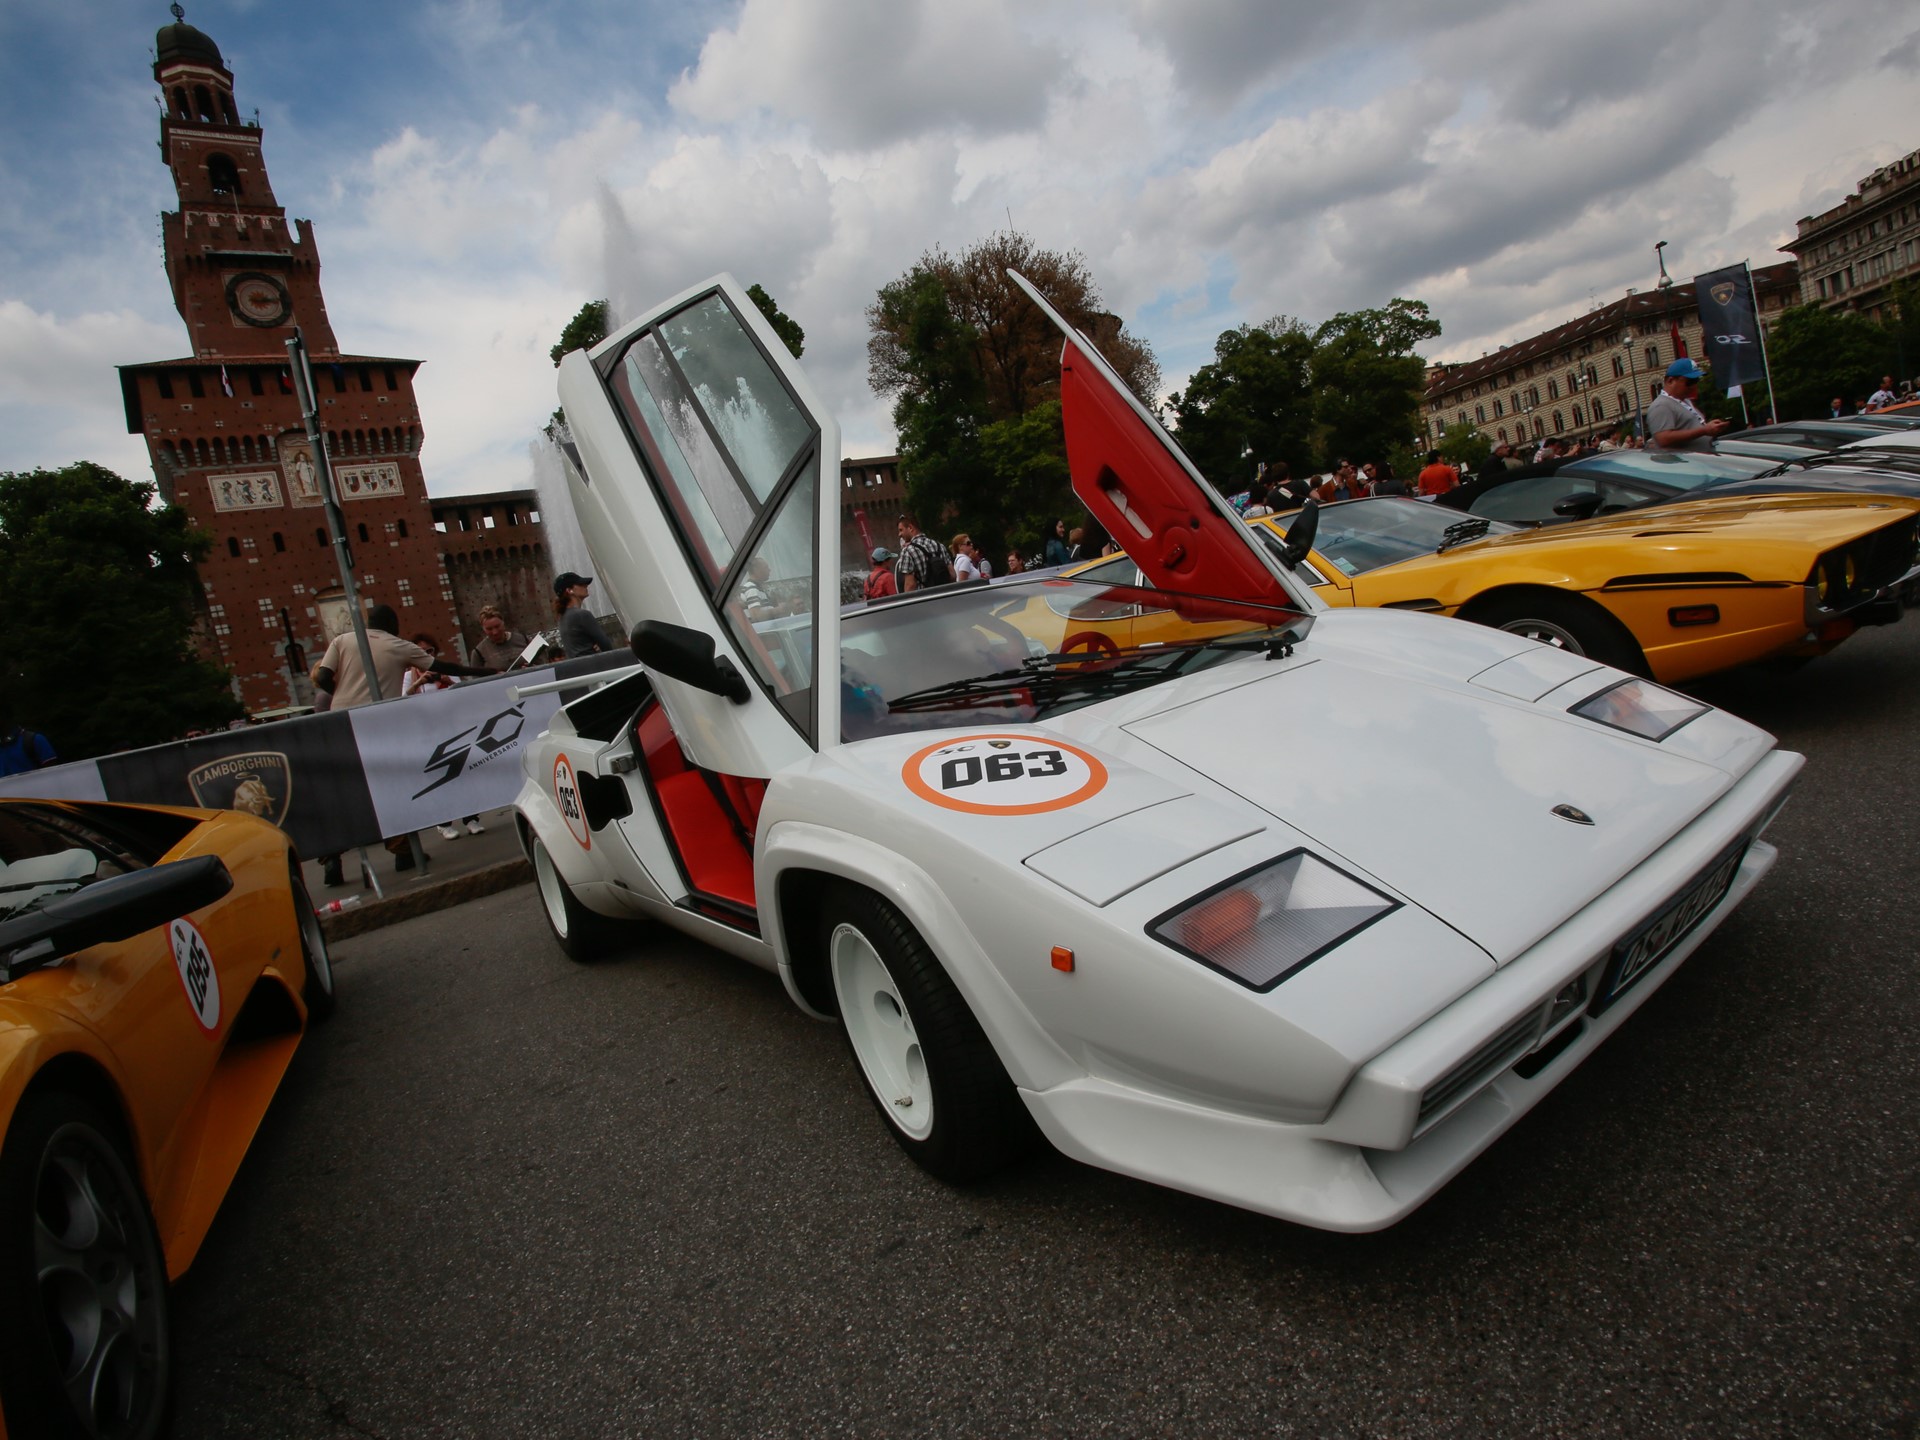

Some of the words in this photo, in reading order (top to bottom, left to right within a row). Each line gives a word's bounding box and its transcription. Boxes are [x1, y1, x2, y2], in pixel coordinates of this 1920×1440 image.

[196, 756, 282, 786] LAMBORGHINI
[468, 741, 518, 771] ANNIVERSARIO
[941, 750, 1067, 789] 063
[559, 786, 580, 820] 063
[187, 930, 211, 1017] 095
